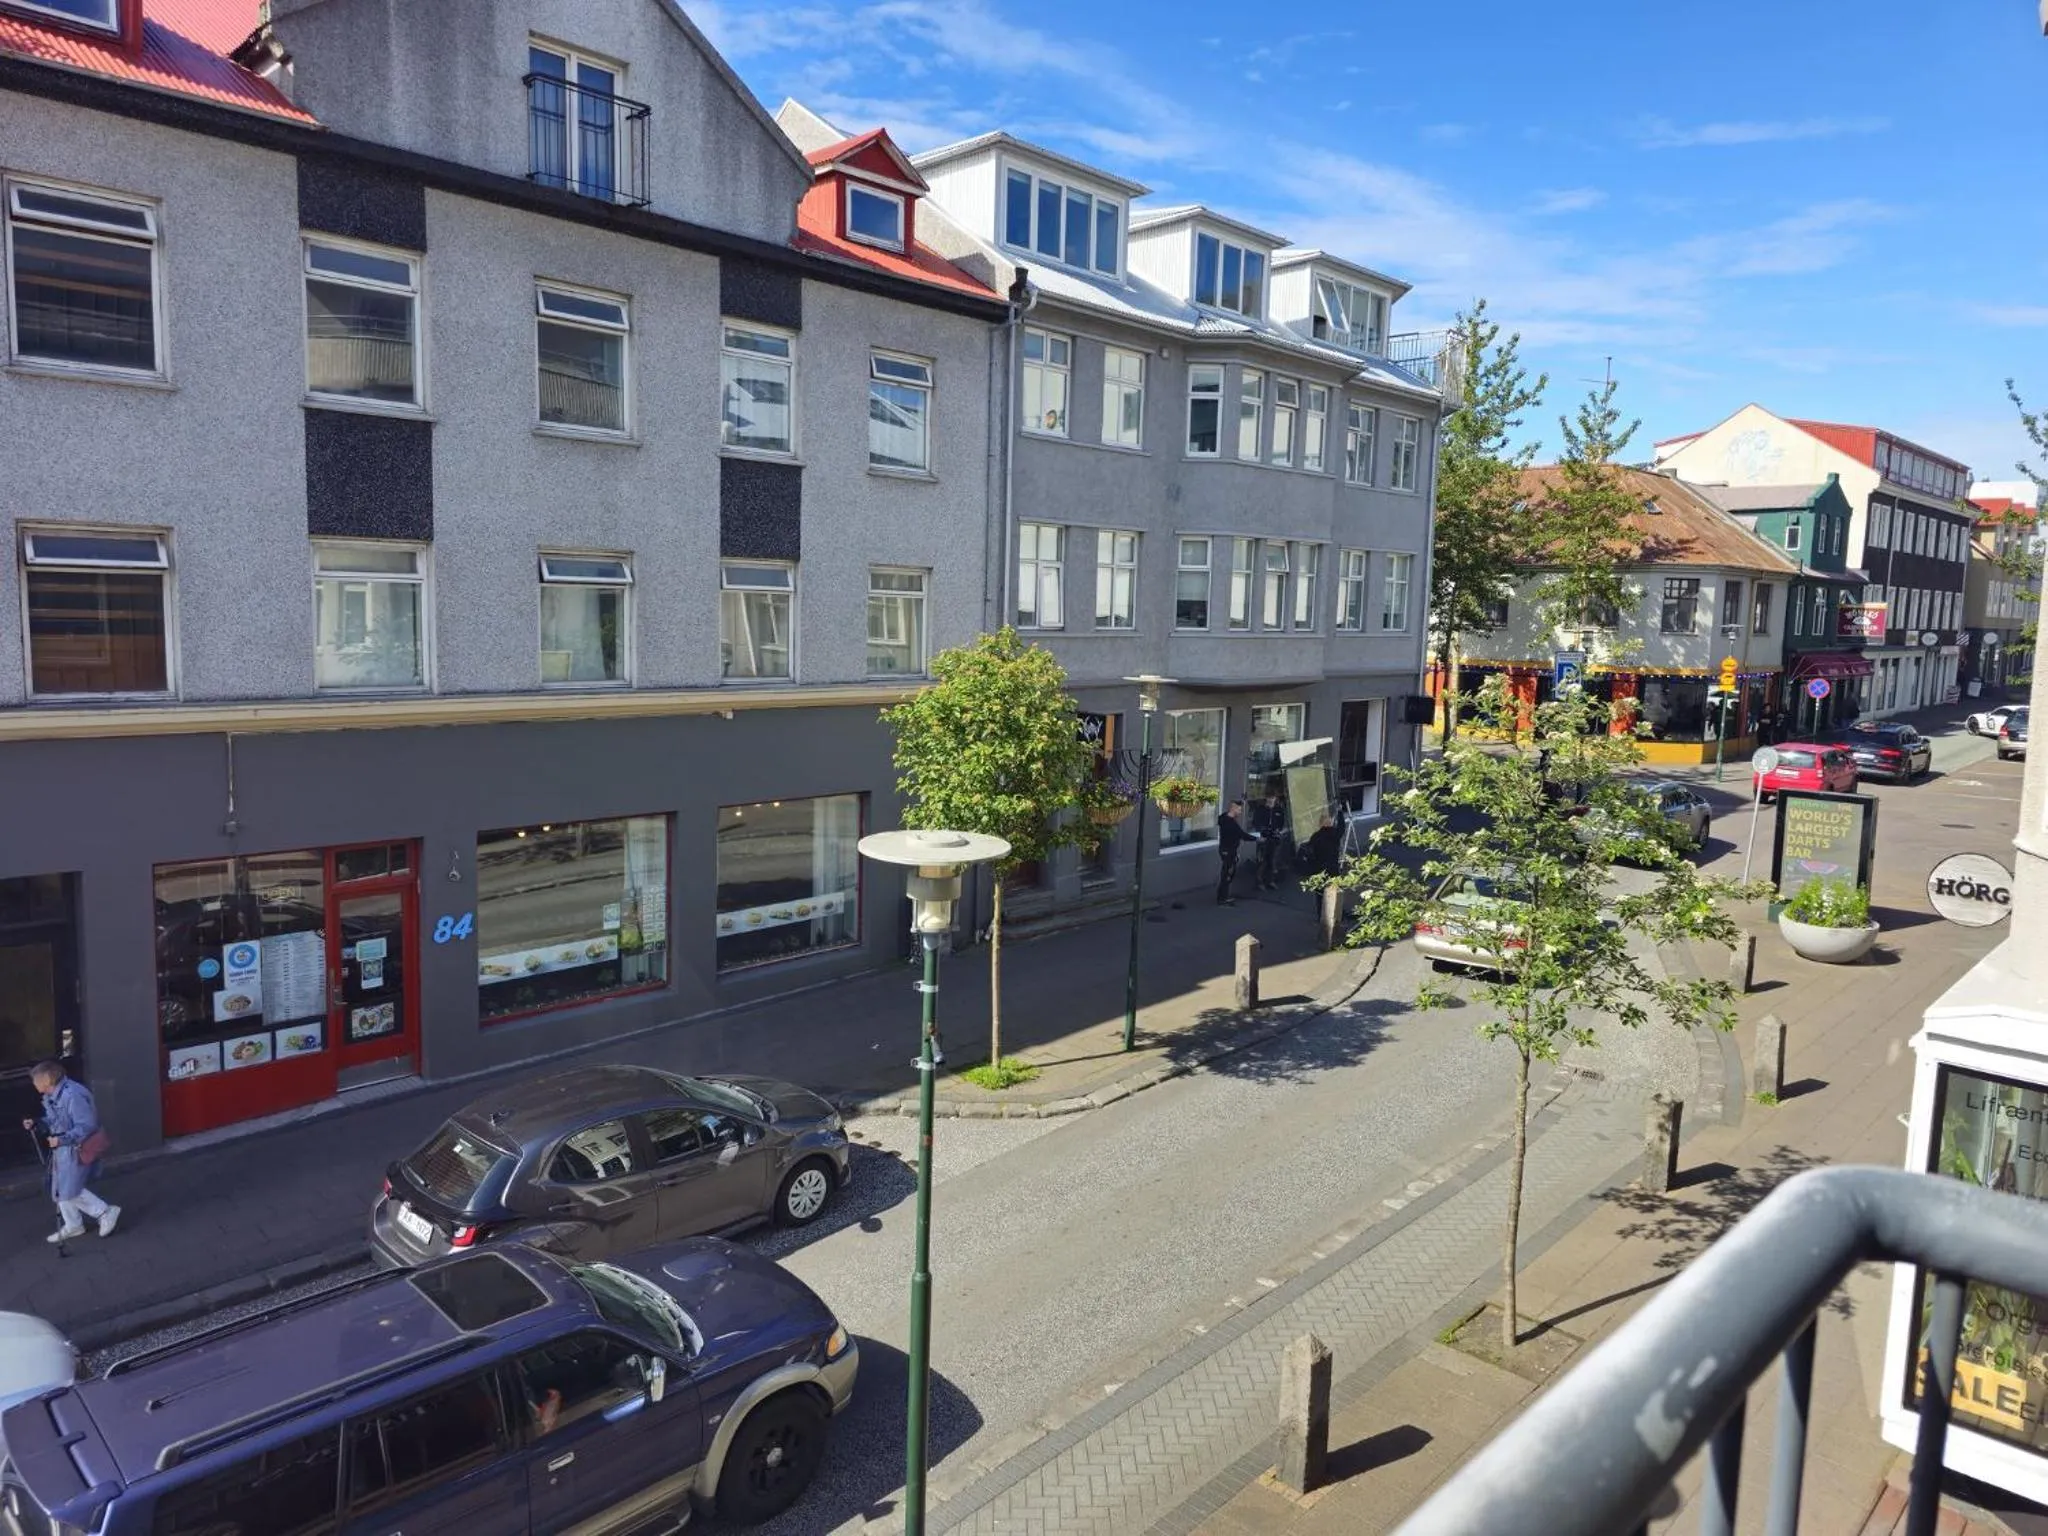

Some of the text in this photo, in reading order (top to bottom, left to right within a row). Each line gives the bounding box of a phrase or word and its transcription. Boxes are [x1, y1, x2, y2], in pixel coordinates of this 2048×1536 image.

[1789, 807, 1853, 826] WORLD'S
[1787, 821, 1851, 838] LARGEST
[1786, 833, 1831, 849] DARTS
[1785, 845, 1812, 859] BAR
[1935, 876, 2010, 905] HÖRG
[433, 911, 473, 944] 84
